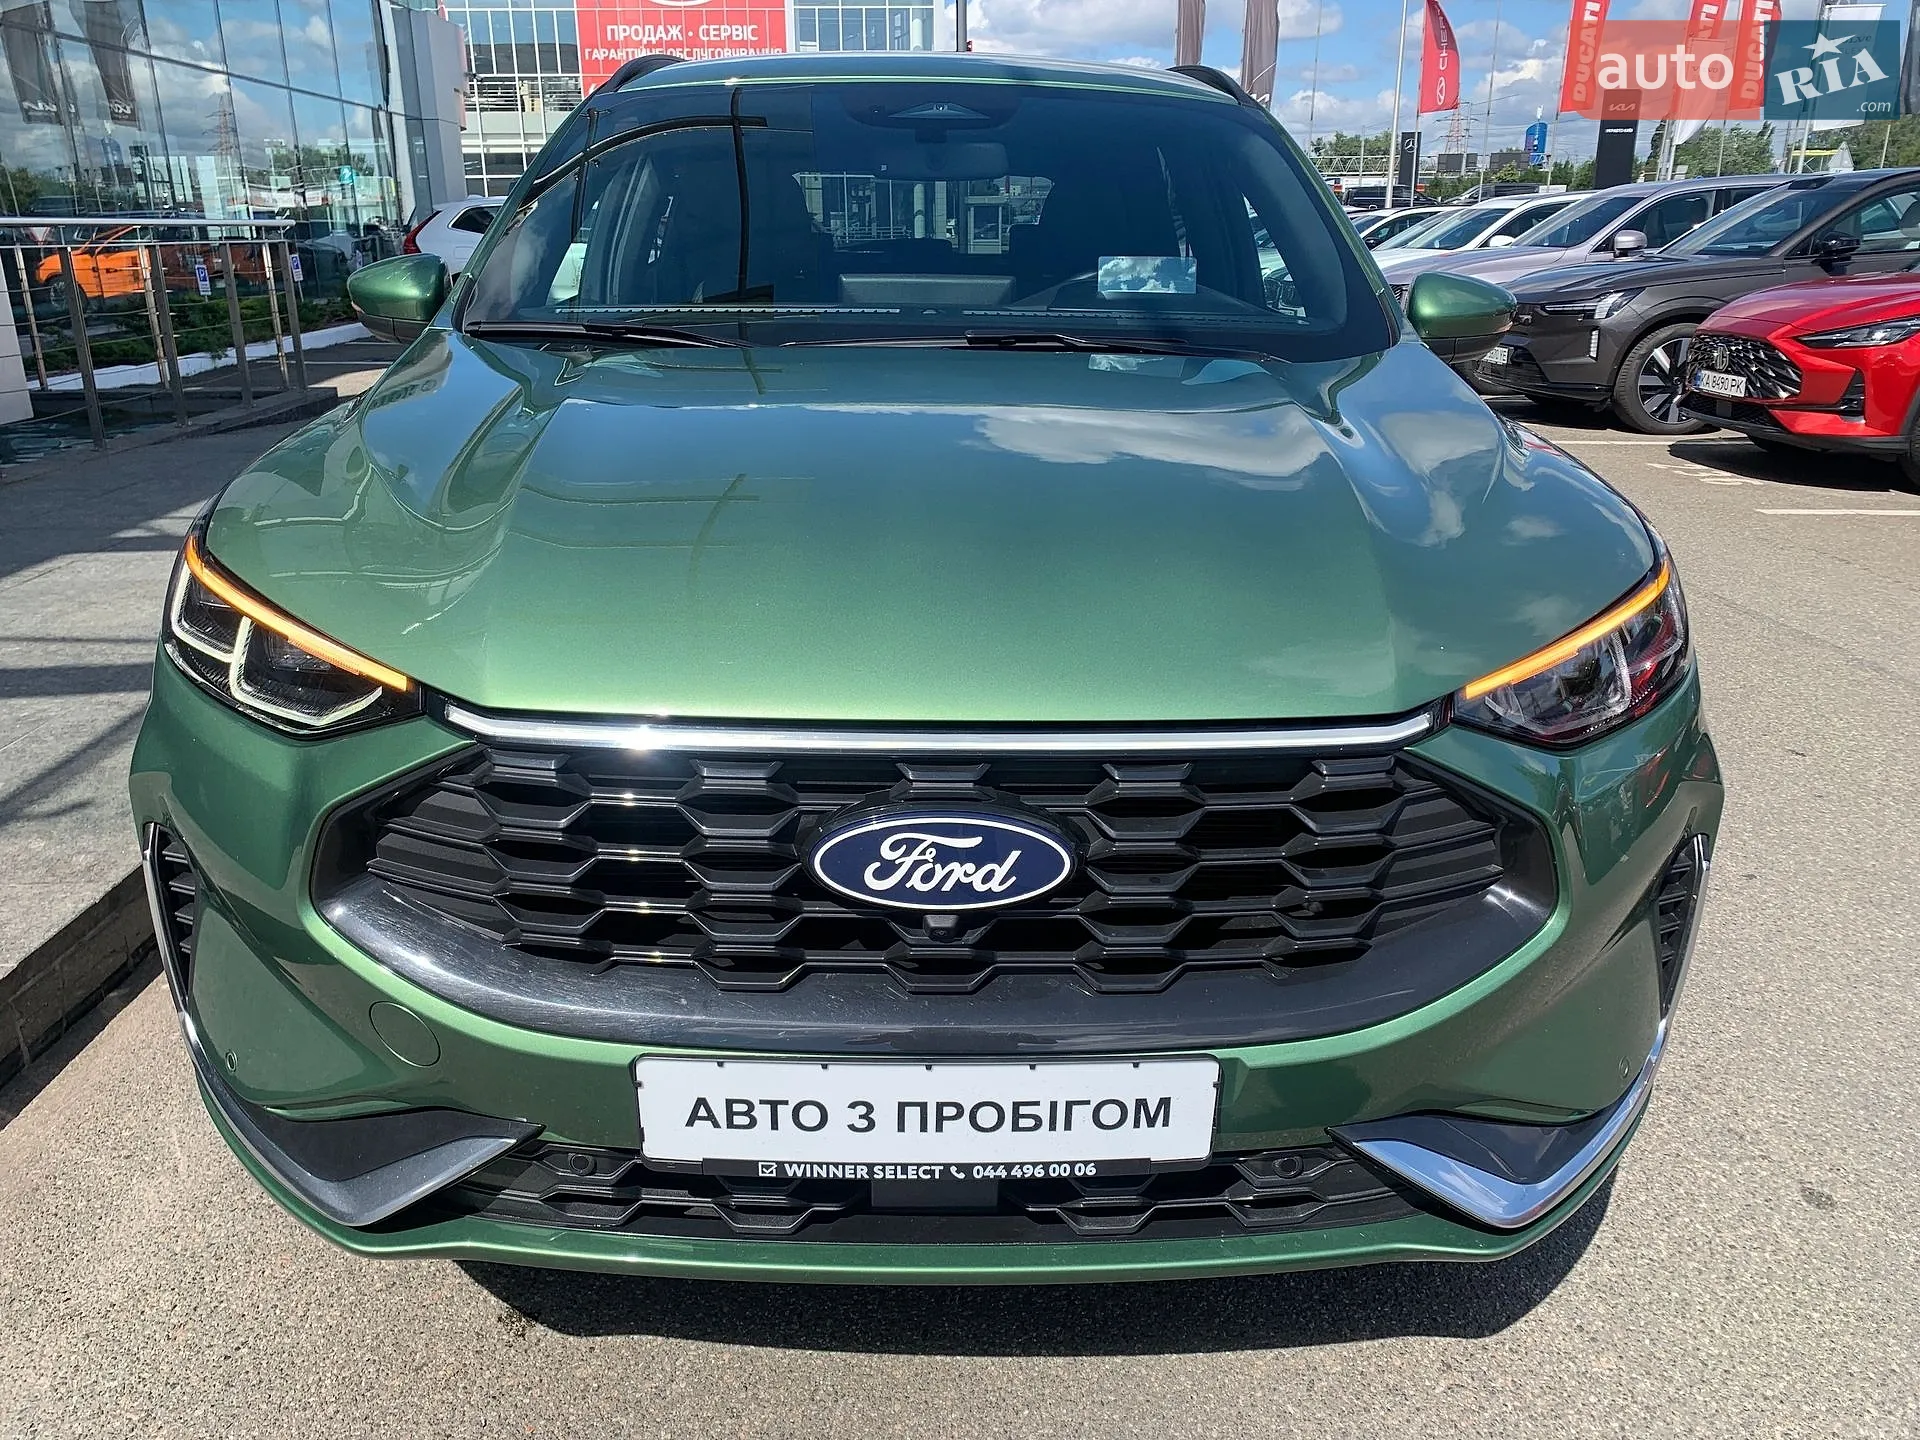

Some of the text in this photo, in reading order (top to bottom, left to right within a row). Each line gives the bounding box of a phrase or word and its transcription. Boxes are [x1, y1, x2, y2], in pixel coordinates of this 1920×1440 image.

[606, 25, 759, 43] ПРОДАЖ СЕРВІС
[1572, 1, 1601, 102] DUCATI
[1740, 0, 1774, 100] DUCATI
[863, 832, 1022, 893] Ford
[685, 1096, 1172, 1133] АВТО З ПРОБІГОМ
[784, 1162, 1097, 1179] WINNER SELECT 044 496 00 06
